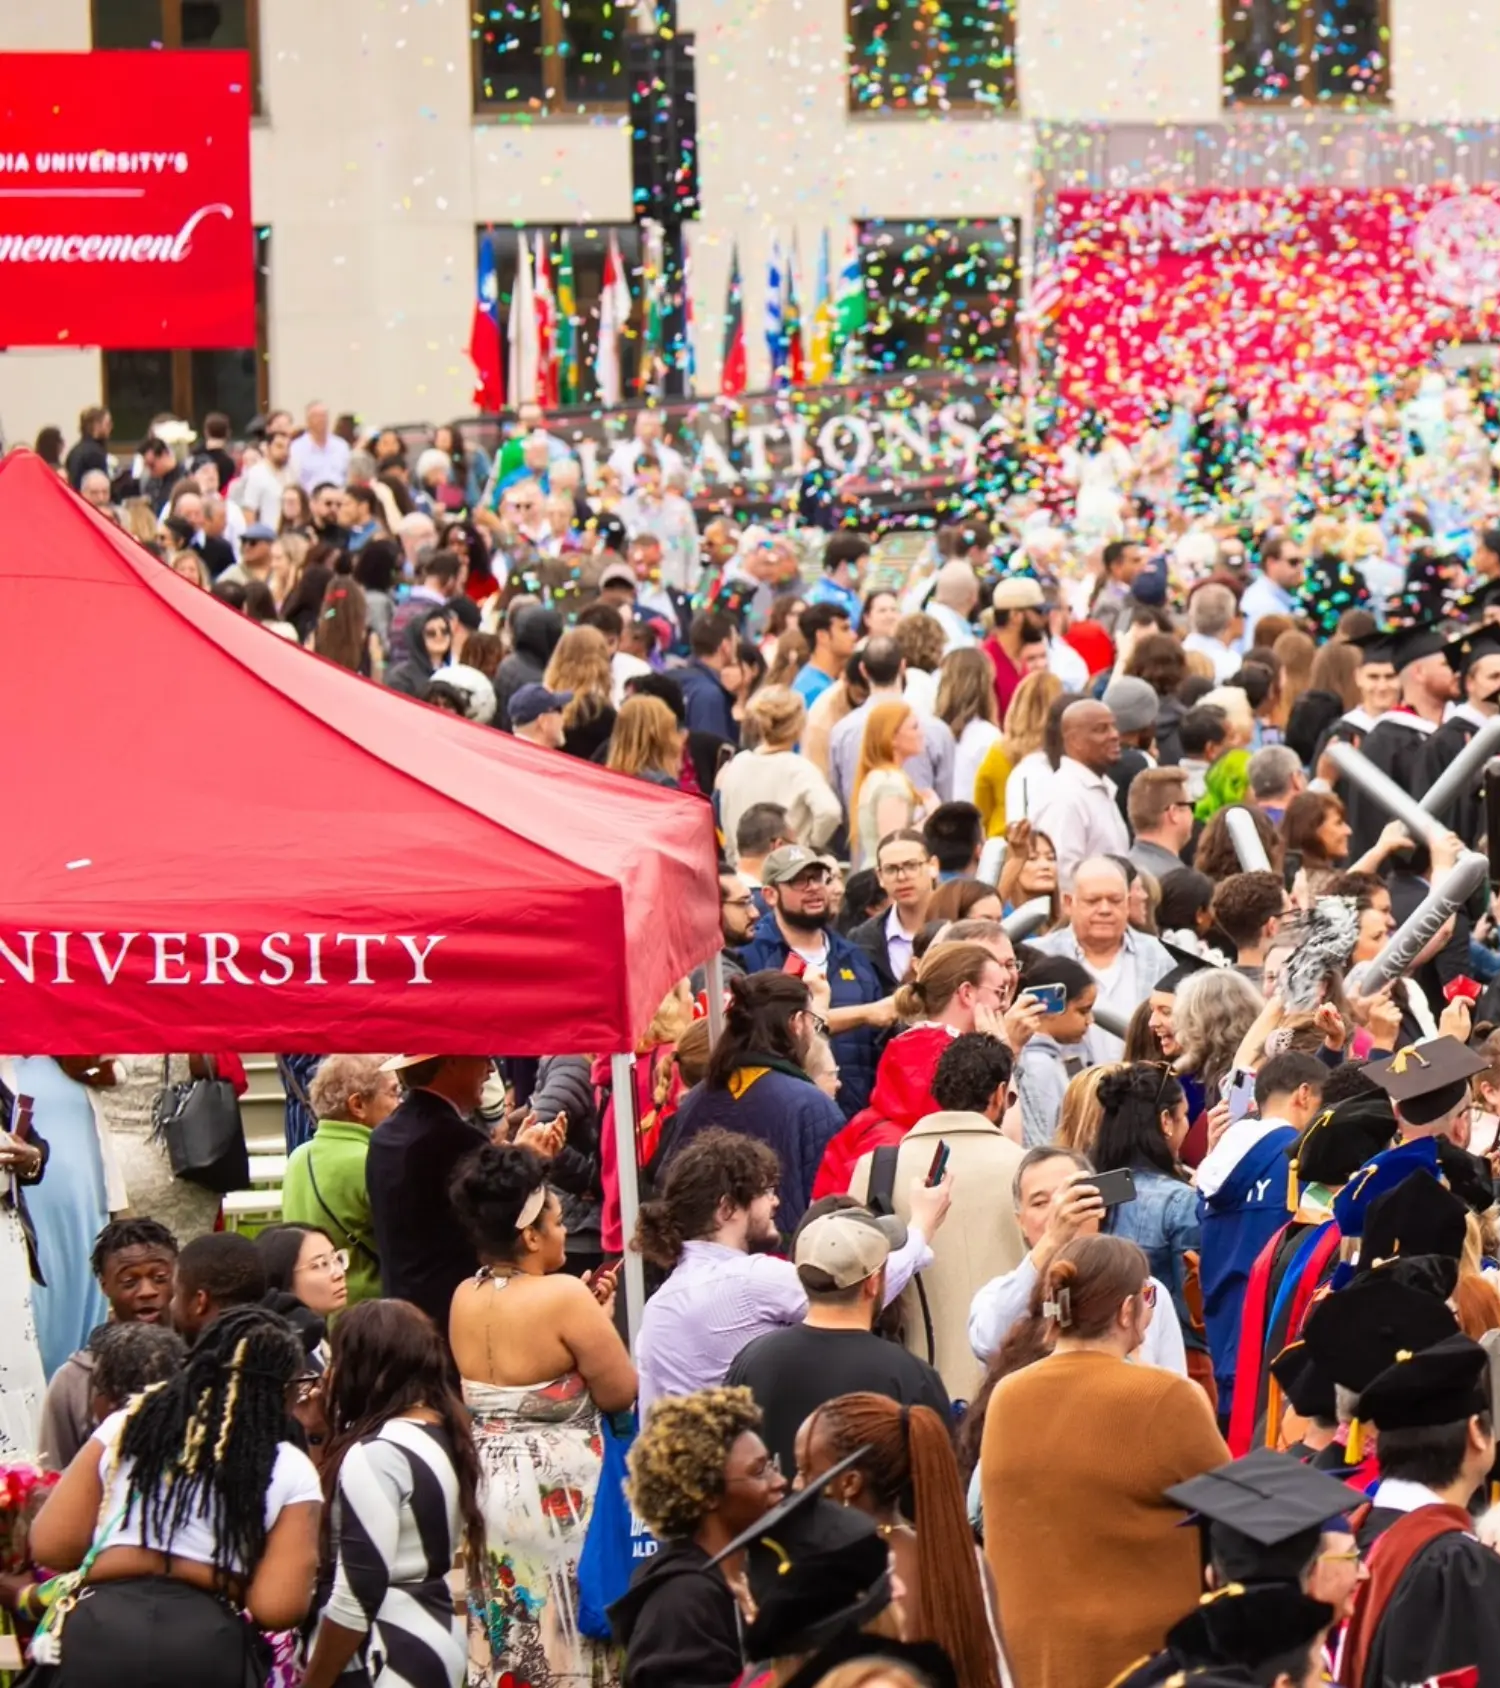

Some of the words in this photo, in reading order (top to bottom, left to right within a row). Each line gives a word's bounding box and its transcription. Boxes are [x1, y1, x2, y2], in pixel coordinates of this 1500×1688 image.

[35, 150, 189, 174] UNIVERSITY'S
[692, 399, 980, 484] ATIONS
[1380, 897, 1462, 979] ARCADIA
